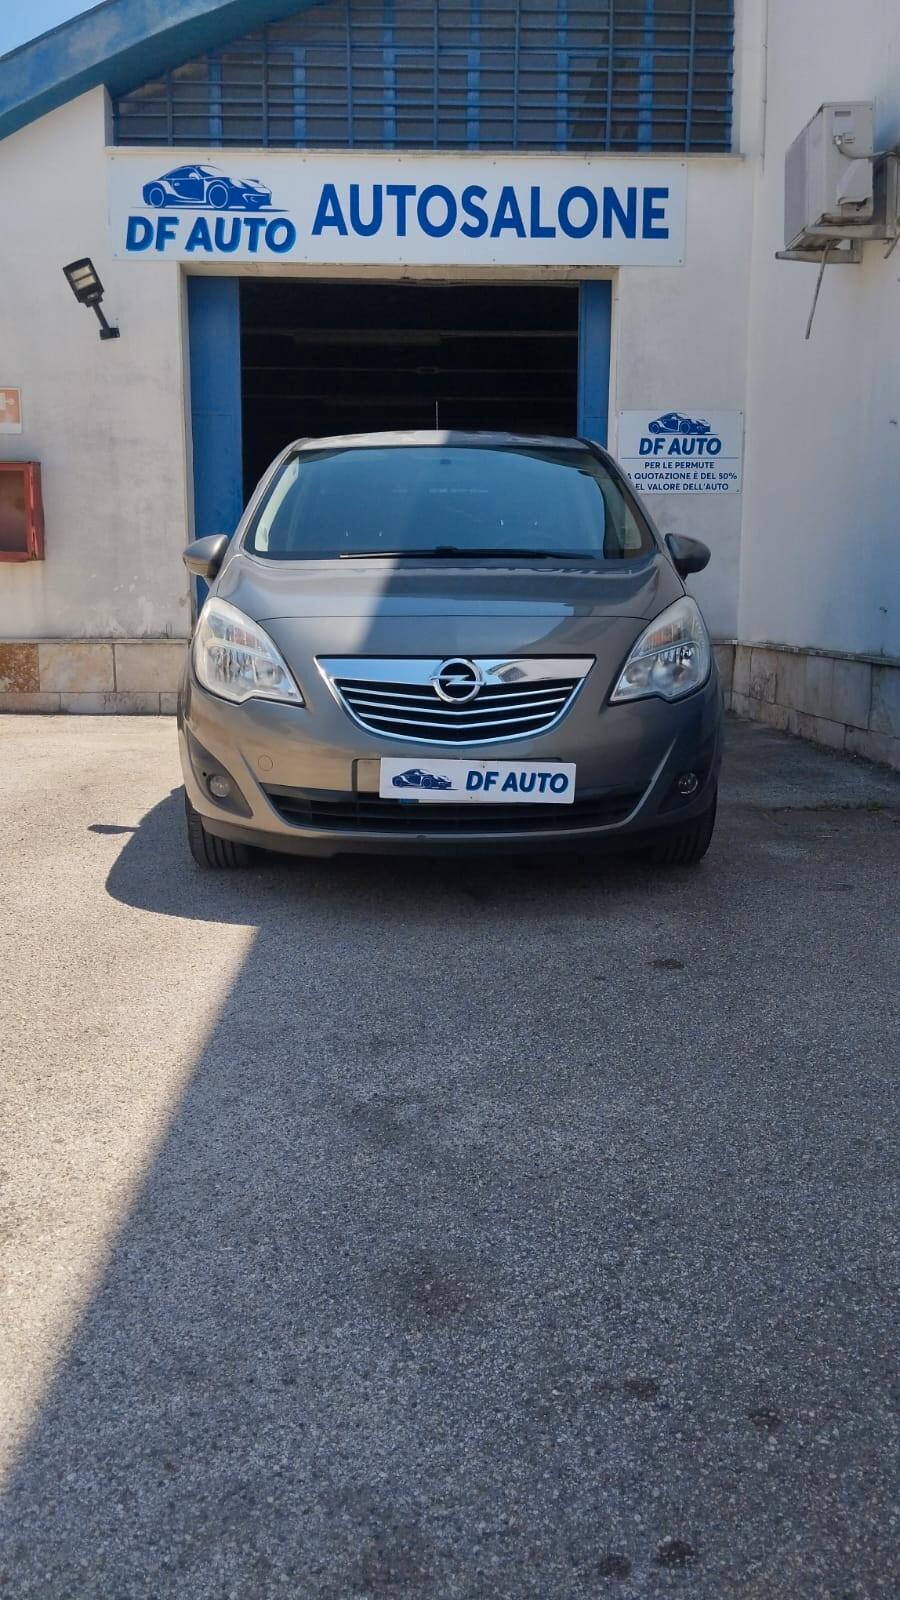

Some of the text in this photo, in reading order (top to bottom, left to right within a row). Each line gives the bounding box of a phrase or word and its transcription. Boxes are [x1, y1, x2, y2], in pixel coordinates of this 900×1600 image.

[312, 183, 669, 240] AUTOSALONE
[126, 216, 296, 253] DF AUTO
[639, 438, 722, 455] DF AUTO
[634, 472, 691, 480] QUOTAZIONE
[694, 471, 699, 480] È
[719, 472, 738, 480] 50%
[466, 771, 569, 793] DF AUTO
